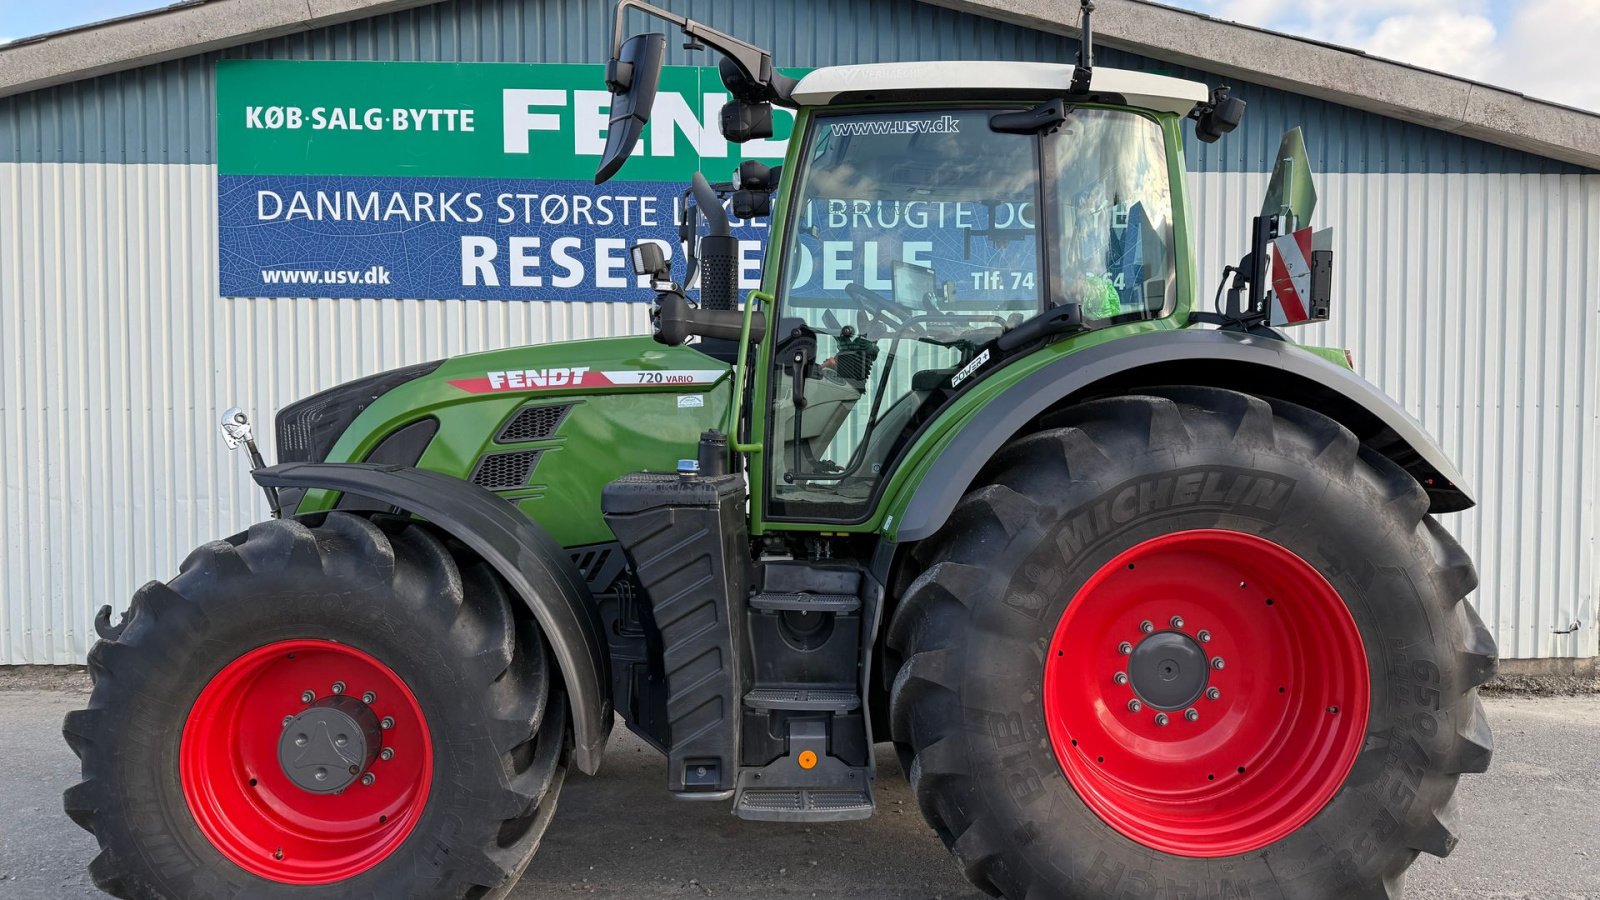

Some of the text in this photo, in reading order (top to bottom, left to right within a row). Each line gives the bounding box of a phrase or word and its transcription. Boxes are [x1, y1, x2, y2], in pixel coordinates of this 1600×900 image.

[831, 116, 960, 136] www.usv.dk
[257, 190, 484, 223] DANMARKS
[496, 193, 658, 227] STØRSTE
[828, 198, 972, 229] BRUGTE
[262, 266, 391, 285] www.usv.dk
[971, 271, 1004, 290] Tlf.
[1010, 272, 1035, 290] 74
[487, 366, 694, 390] FENDT 720 VARIO
[1056, 470, 1292, 565] MICHELIN
